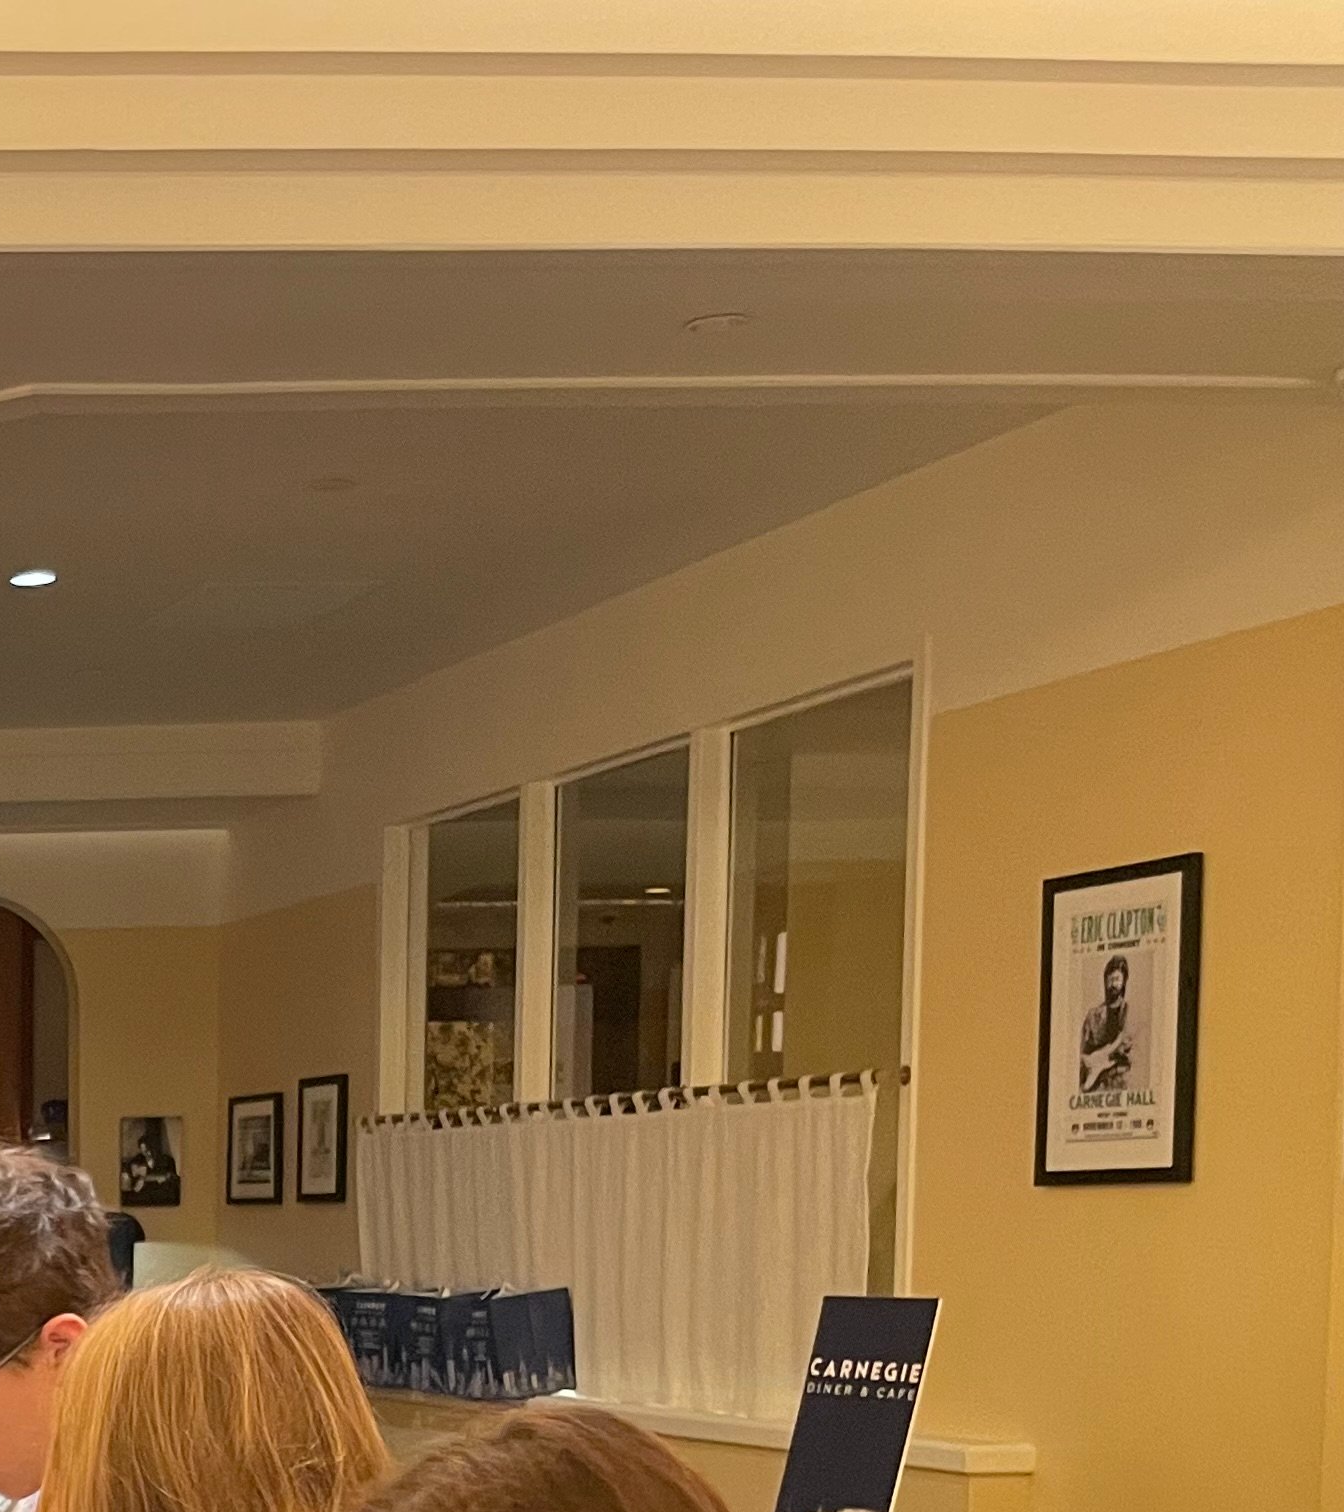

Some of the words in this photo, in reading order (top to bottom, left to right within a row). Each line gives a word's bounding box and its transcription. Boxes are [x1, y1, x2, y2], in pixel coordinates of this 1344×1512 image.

[1107, 907, 1155, 939] CLAPTON
[1068, 1092, 1122, 1110] CARNEGIE
[1126, 1090, 1156, 1107] HALL
[810, 1357, 922, 1384] CARNEGIE
[805, 1381, 853, 1396] DINER
[875, 1386, 917, 1402] CAFE
